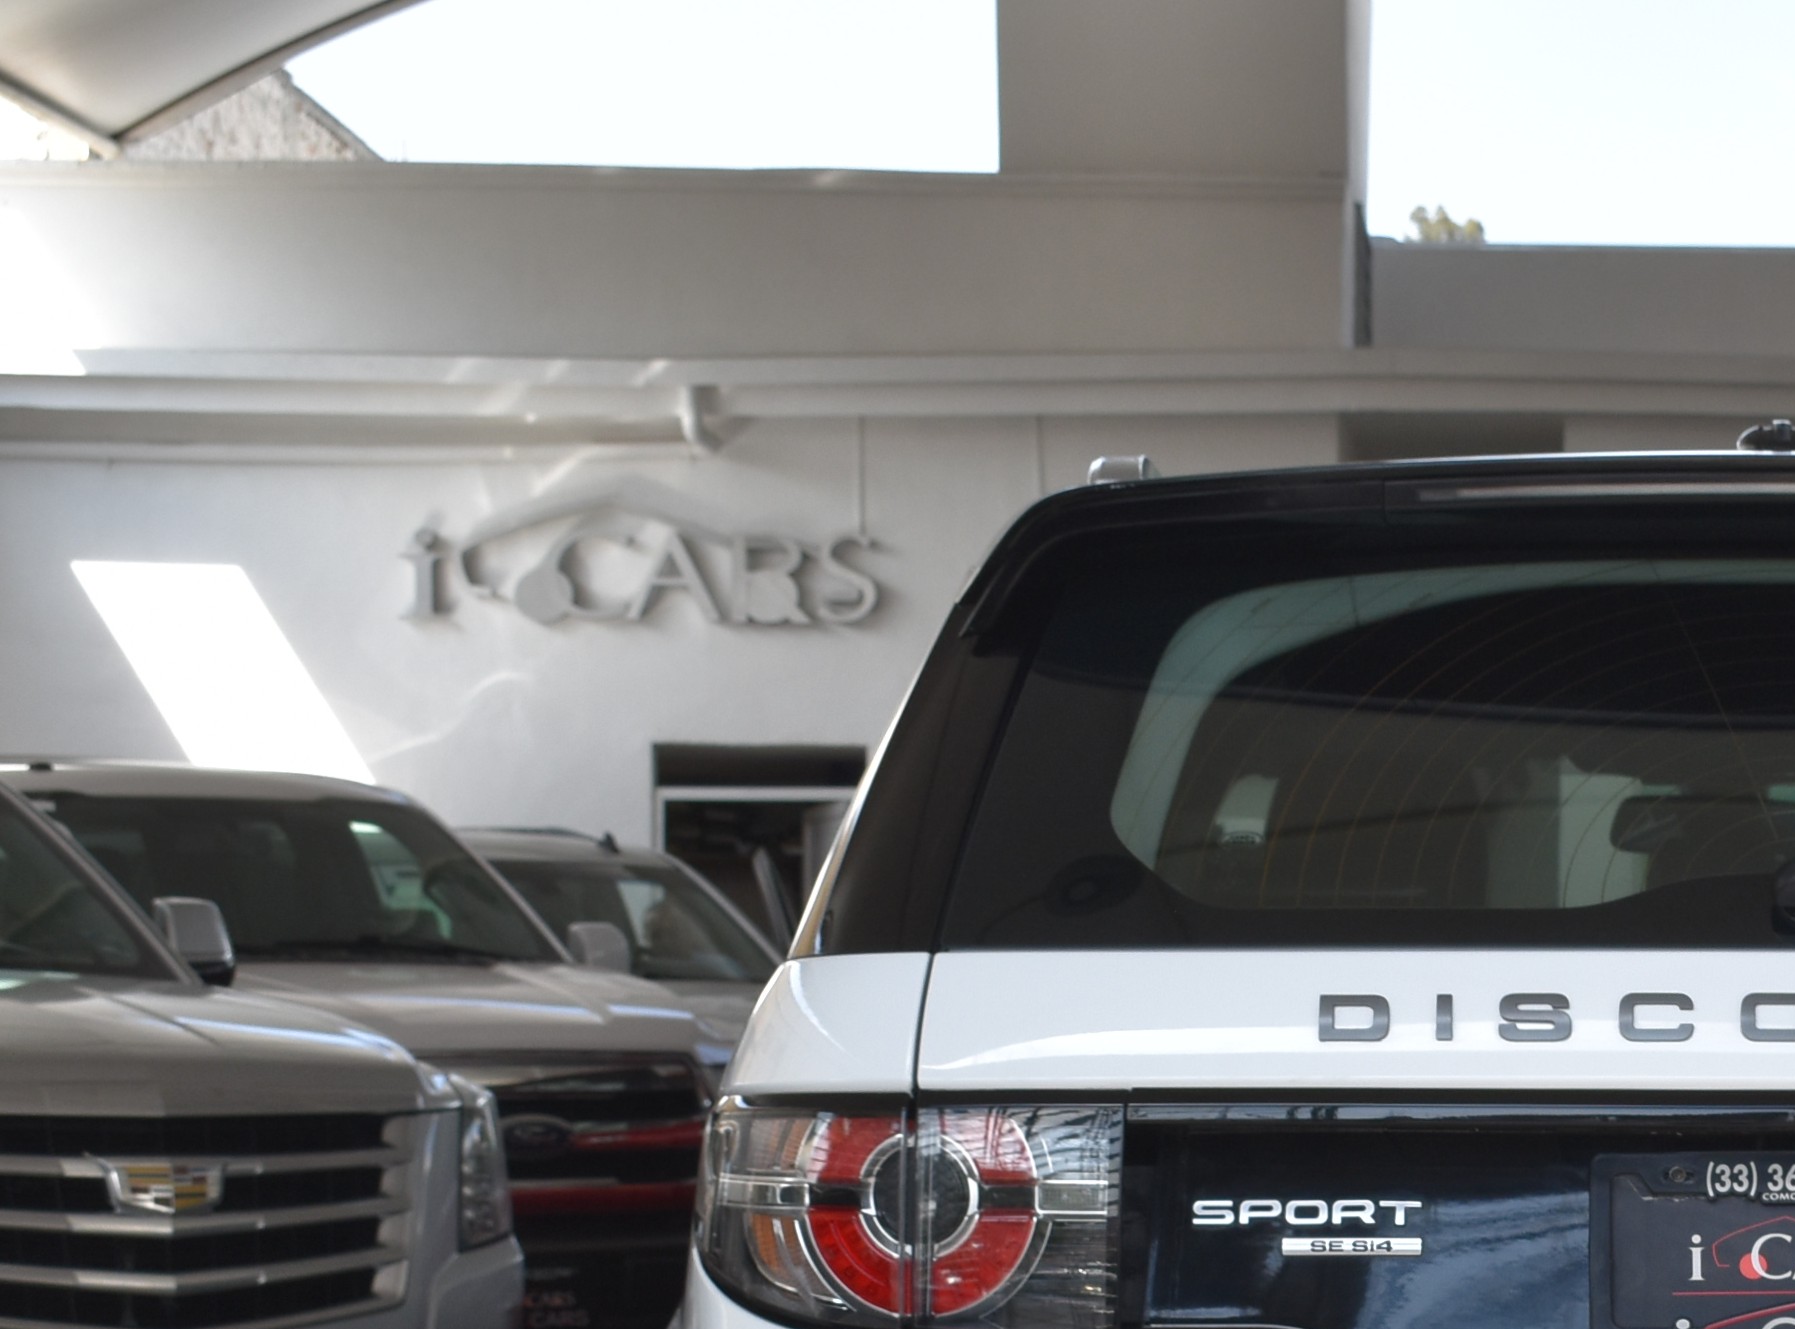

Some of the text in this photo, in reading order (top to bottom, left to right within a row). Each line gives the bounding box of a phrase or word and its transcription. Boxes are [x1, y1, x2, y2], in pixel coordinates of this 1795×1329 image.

[1706, 1161, 1758, 1197] (33)
[1192, 1199, 1422, 1226] SPORT
[1310, 1239, 1394, 1253] SE Si4
